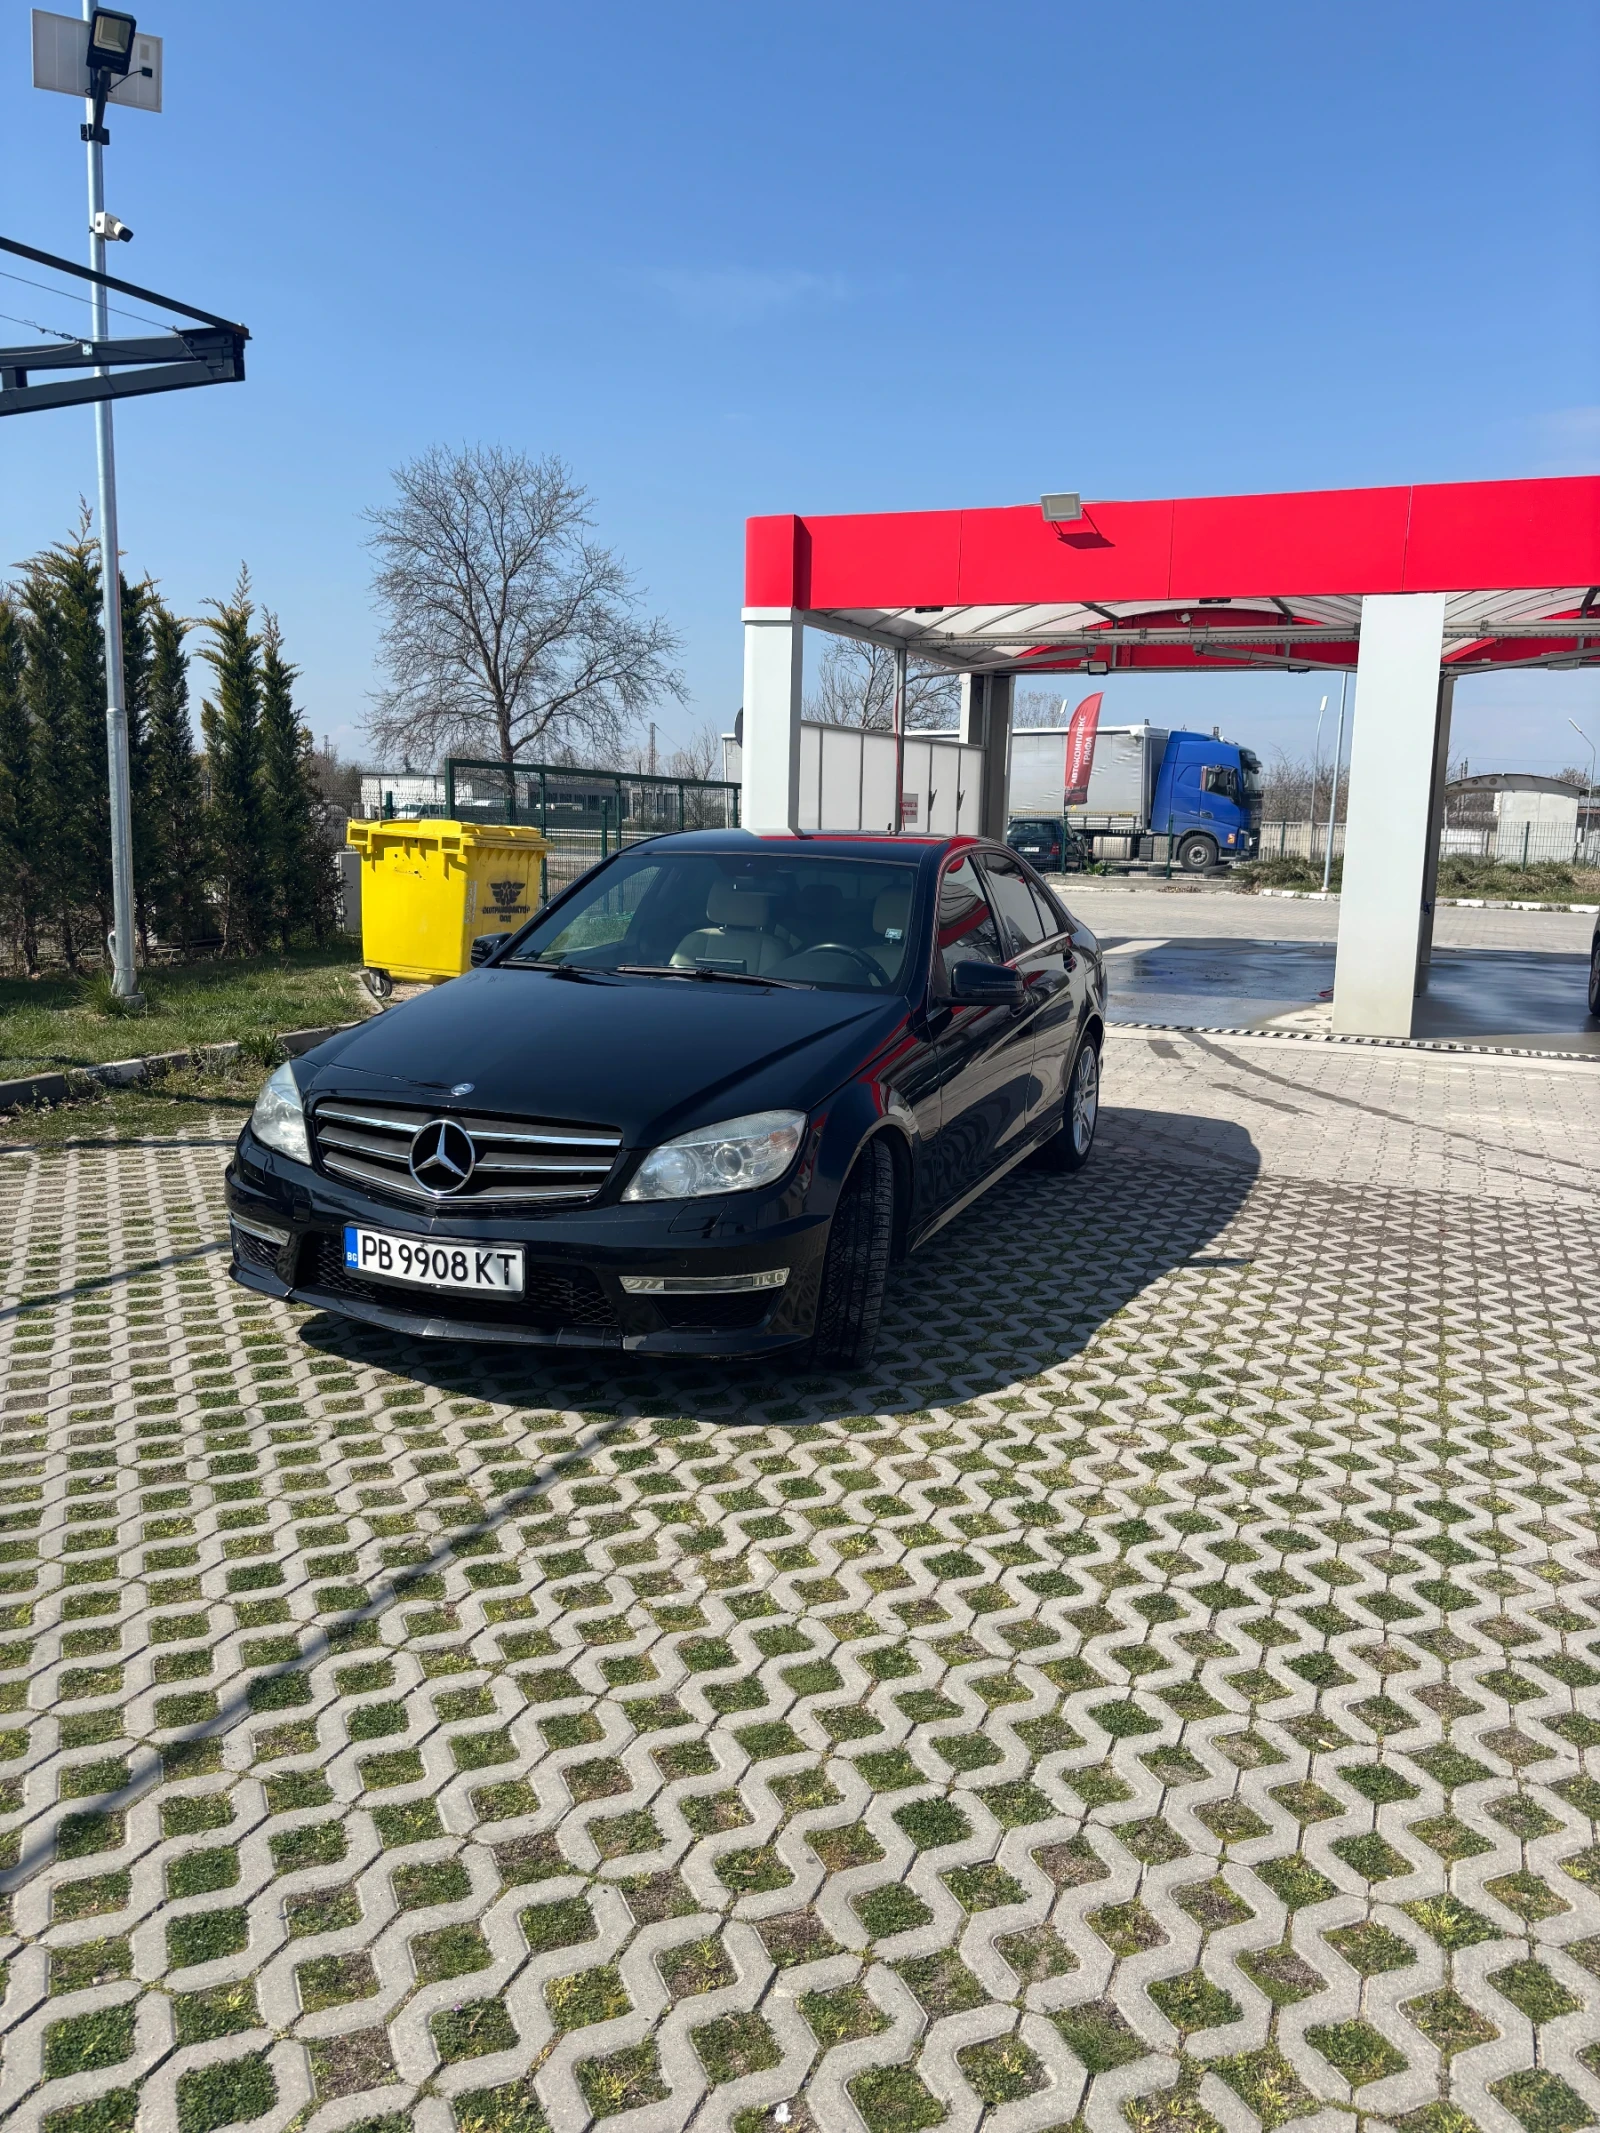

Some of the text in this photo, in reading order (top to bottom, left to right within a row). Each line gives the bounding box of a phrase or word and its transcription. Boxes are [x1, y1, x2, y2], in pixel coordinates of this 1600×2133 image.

[1071, 715, 1086, 783] АВТОКОМПЛЕКС
[1083, 736, 1093, 765] ГРАФА
[347, 1252, 357, 1262] BG
[362, 1235, 517, 1285] PB 9908 KT
